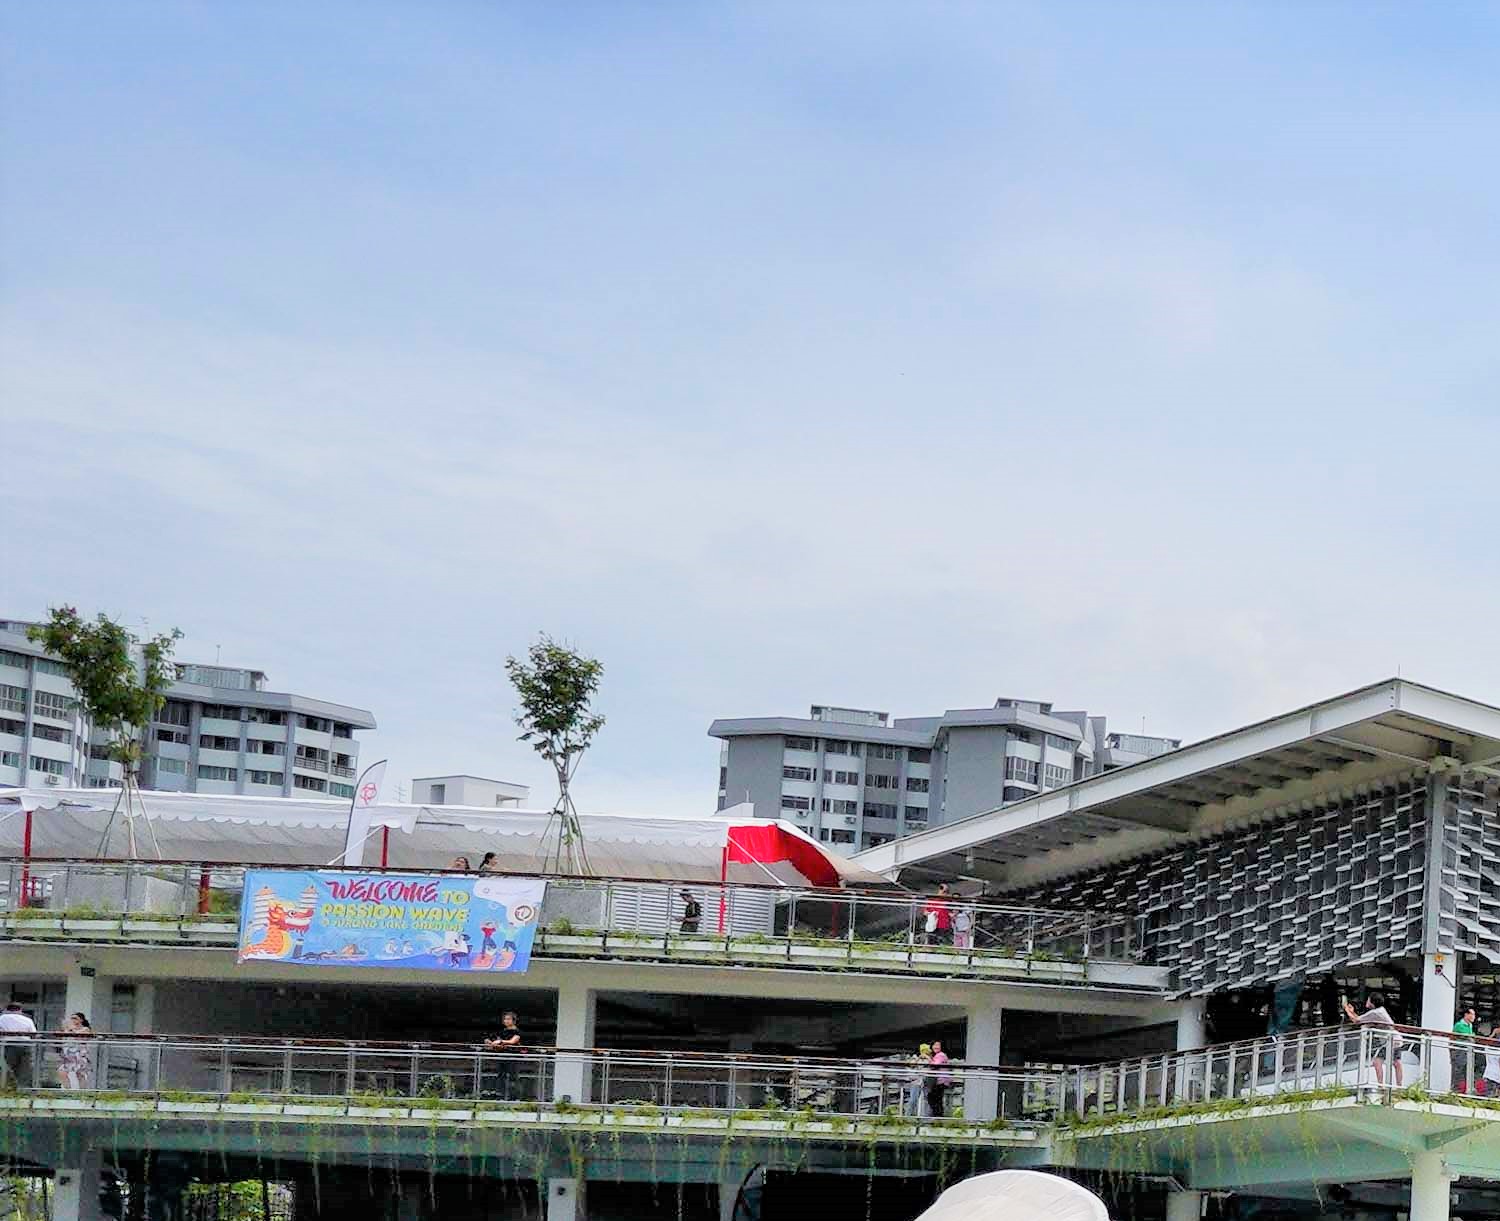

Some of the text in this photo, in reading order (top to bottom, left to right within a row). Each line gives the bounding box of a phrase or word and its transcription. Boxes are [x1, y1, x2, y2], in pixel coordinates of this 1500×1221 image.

[325, 878, 471, 905] WELCOME TO
[321, 902, 471, 922] PASSION WAVE
